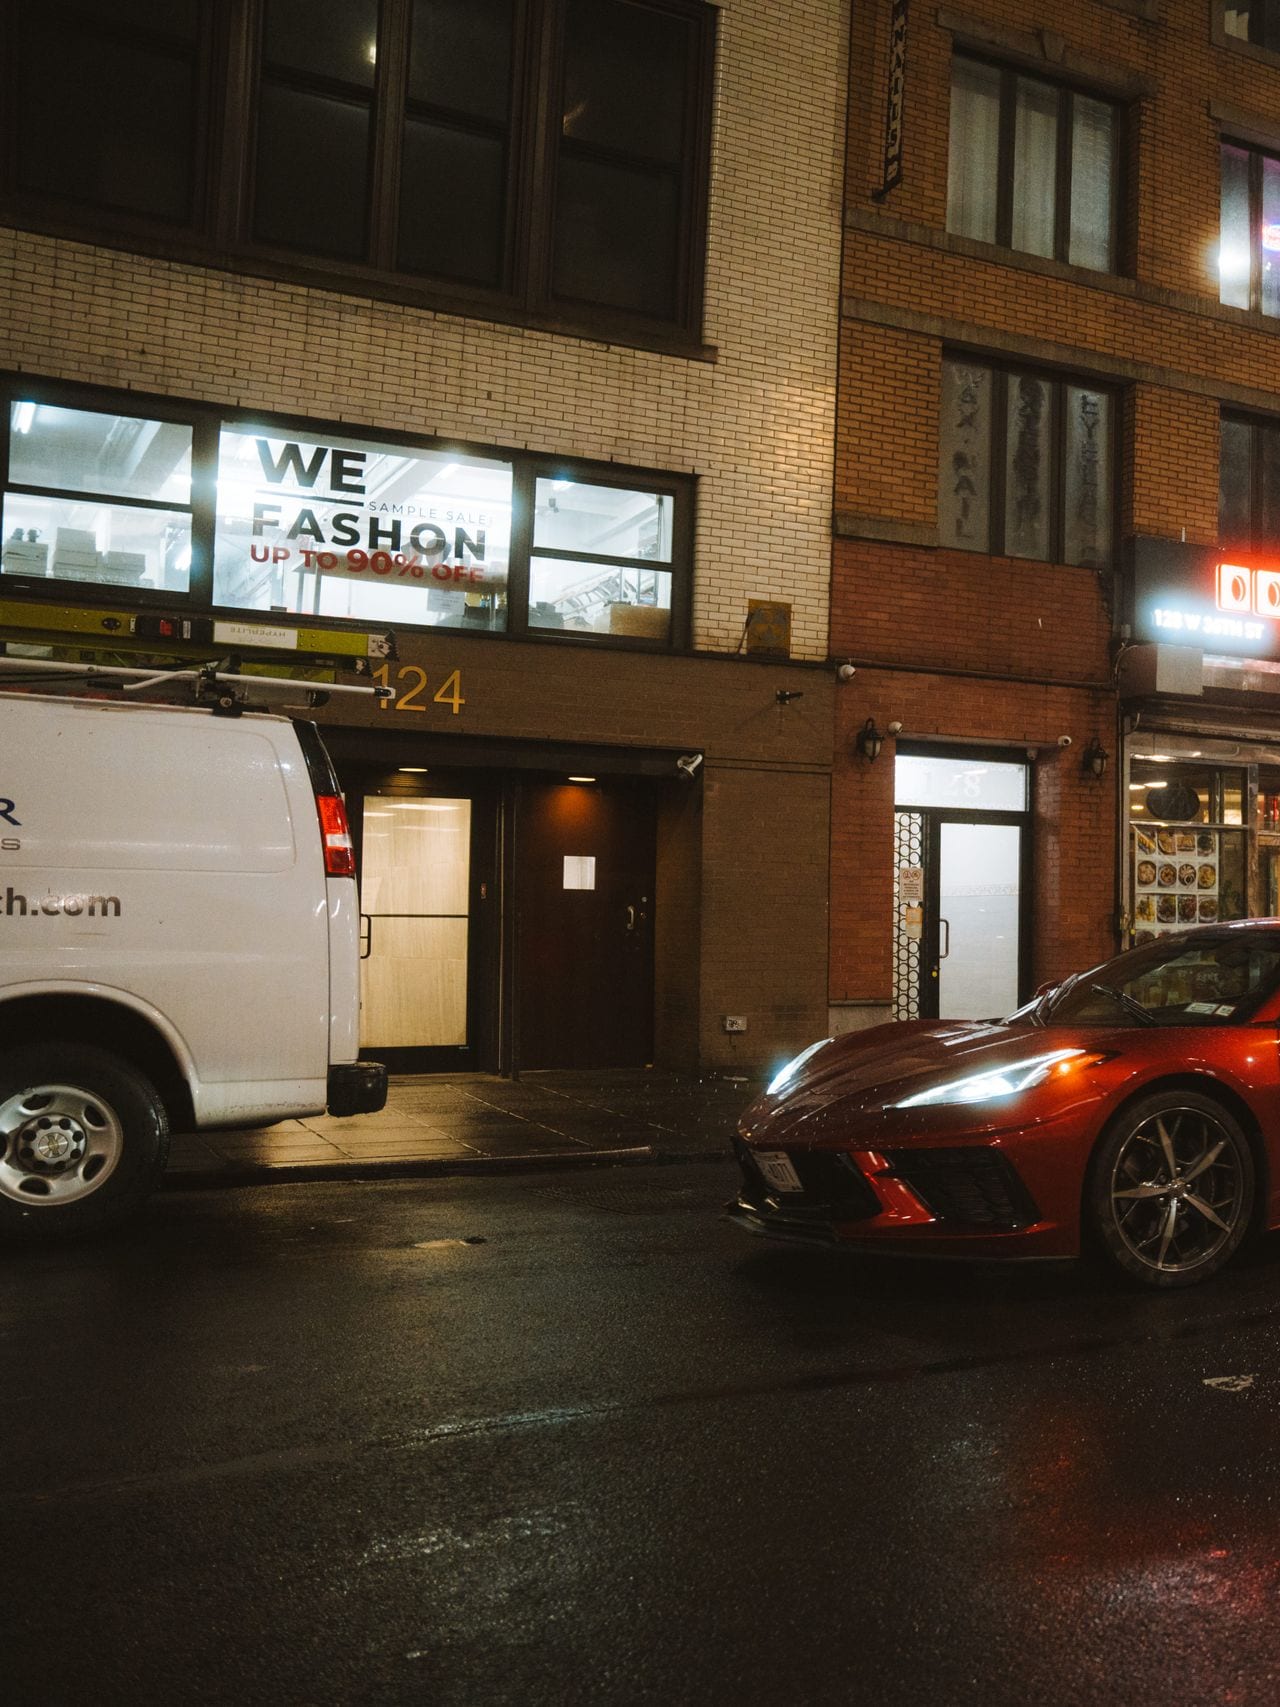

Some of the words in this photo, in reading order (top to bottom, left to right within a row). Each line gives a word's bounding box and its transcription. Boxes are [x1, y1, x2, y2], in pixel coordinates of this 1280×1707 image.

[256, 439, 367, 495] WE
[252, 502, 486, 561] FASHON
[369, 501, 437, 519] SAMPLE
[250, 544, 290, 564] UP
[299, 549, 338, 570] TO
[346, 549, 424, 578] 90%
[432, 564, 484, 583] OFF
[372, 664, 466, 714] 124
[0, 887, 121, 917] h.com
